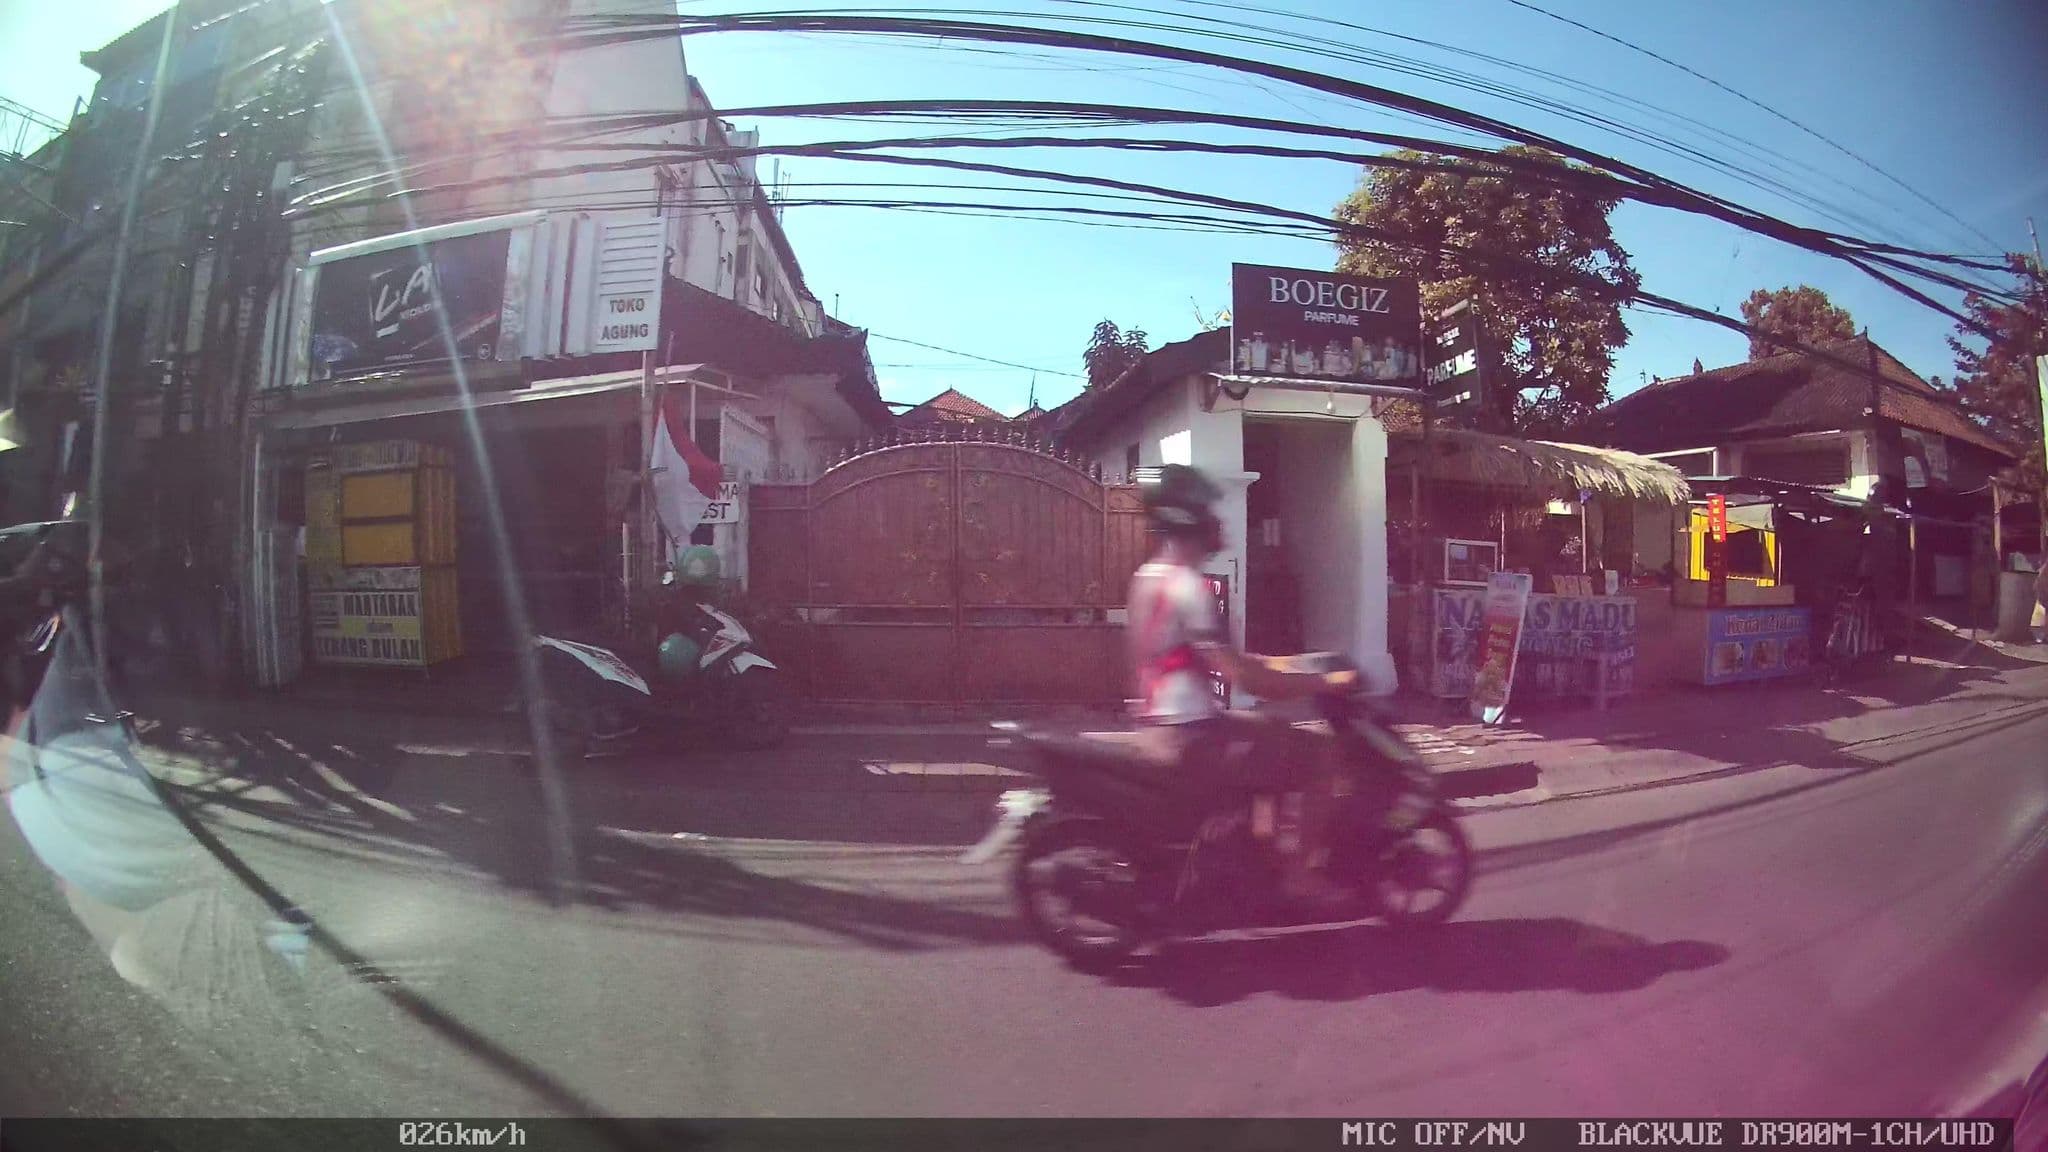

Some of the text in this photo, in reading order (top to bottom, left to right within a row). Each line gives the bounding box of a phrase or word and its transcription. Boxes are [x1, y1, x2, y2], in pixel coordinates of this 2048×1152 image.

[1269, 277, 1391, 314] BOEGIZ
[609, 298, 645, 313] TOKO
[1304, 310, 1360, 327] PARFUME
[601, 323, 649, 340] AGUNG
[1426, 348, 1477, 387] PARFUME
[702, 502, 731, 520] ST
